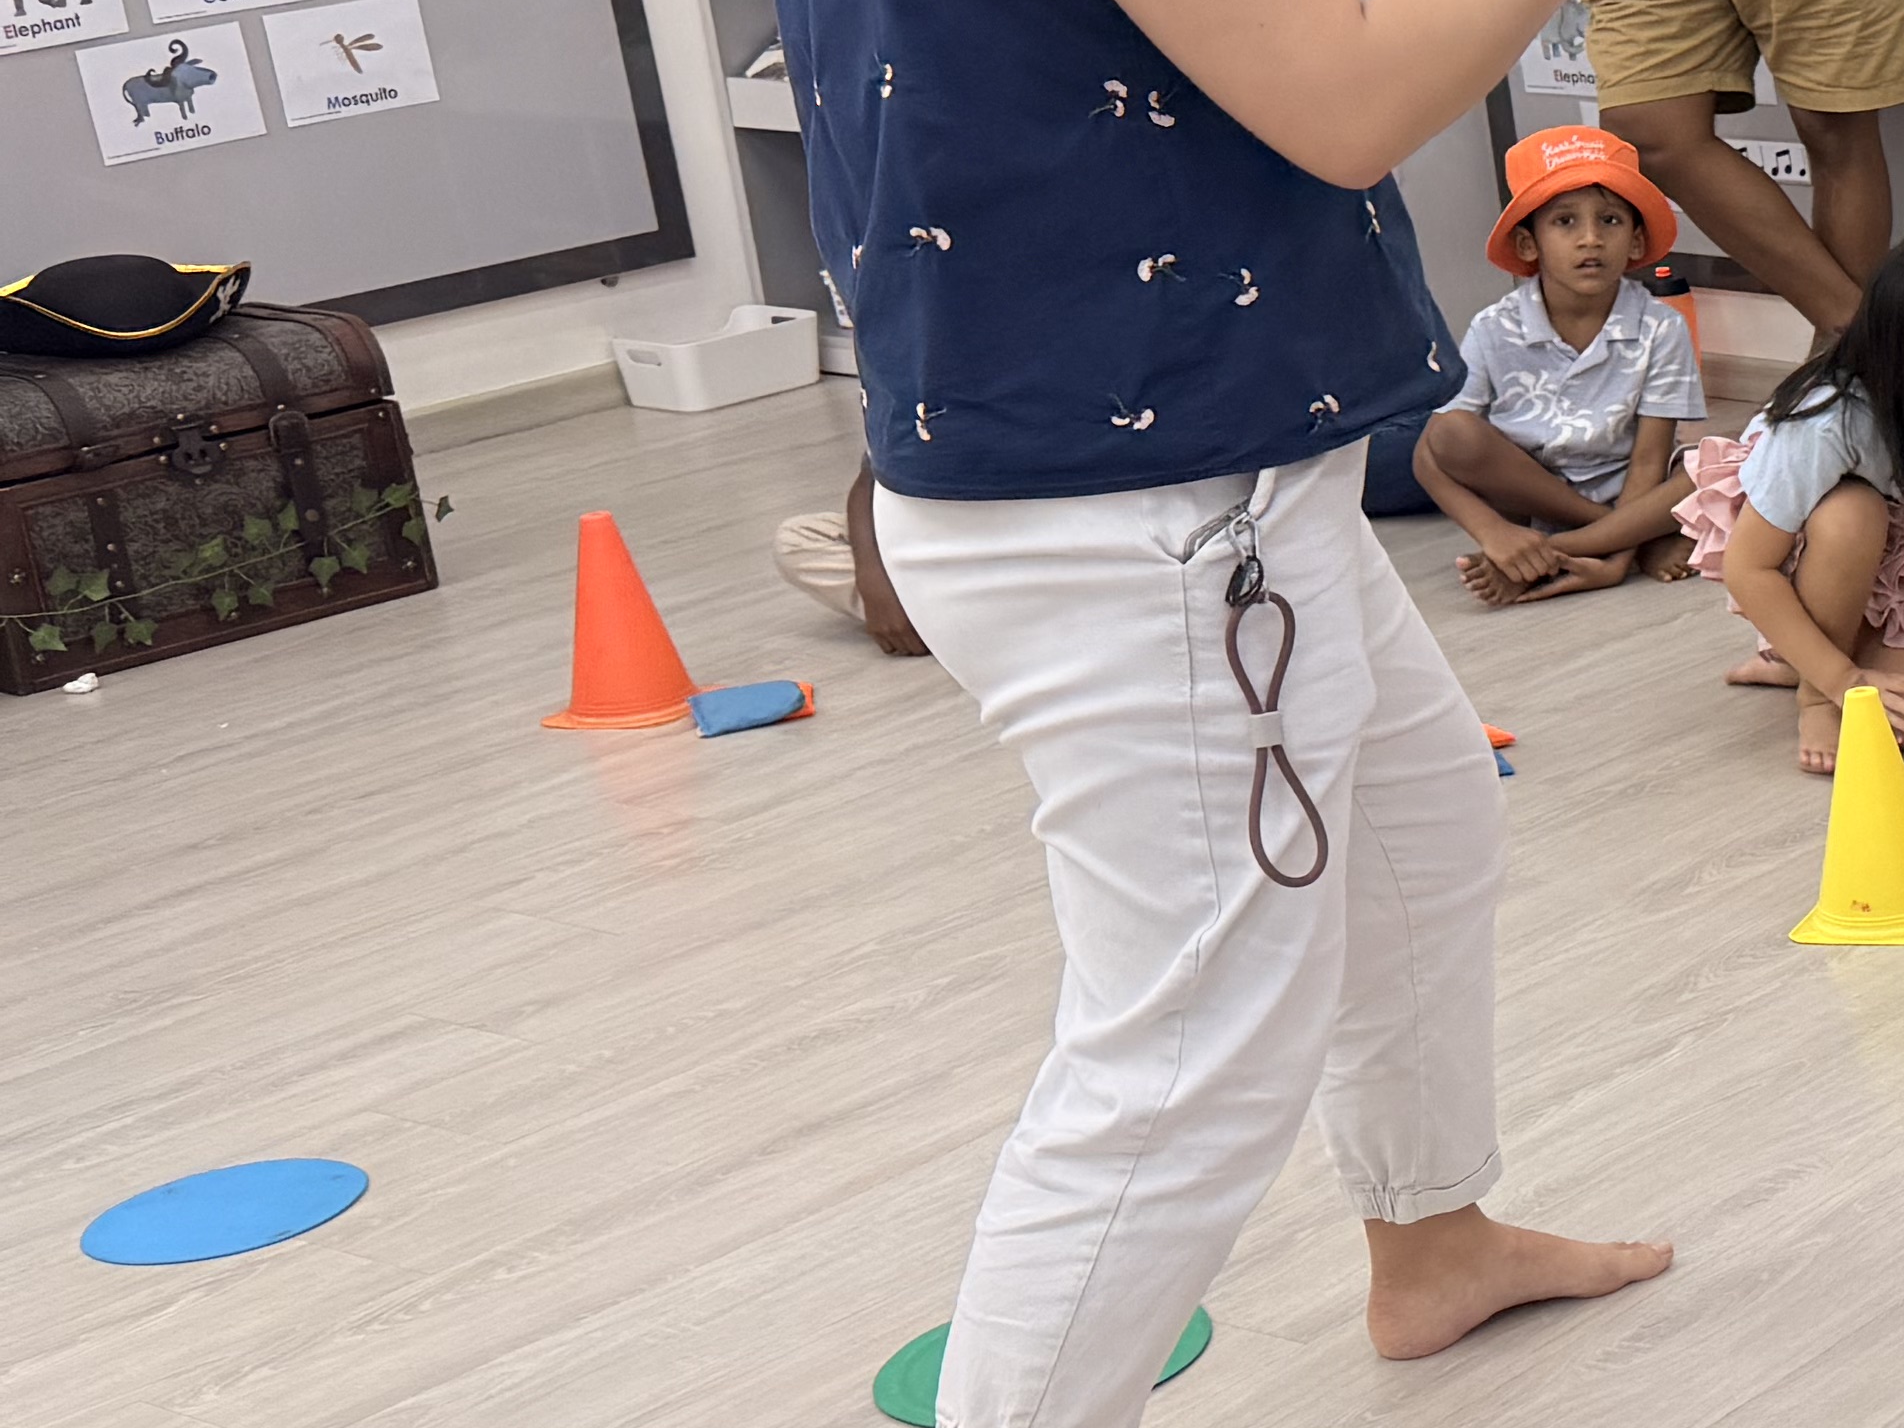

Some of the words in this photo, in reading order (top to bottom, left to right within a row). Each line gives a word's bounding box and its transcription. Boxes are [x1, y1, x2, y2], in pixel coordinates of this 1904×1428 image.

[3, 13, 82, 40] Elephant
[327, 86, 399, 111] Mosquito
[154, 122, 212, 146] Buffalo
